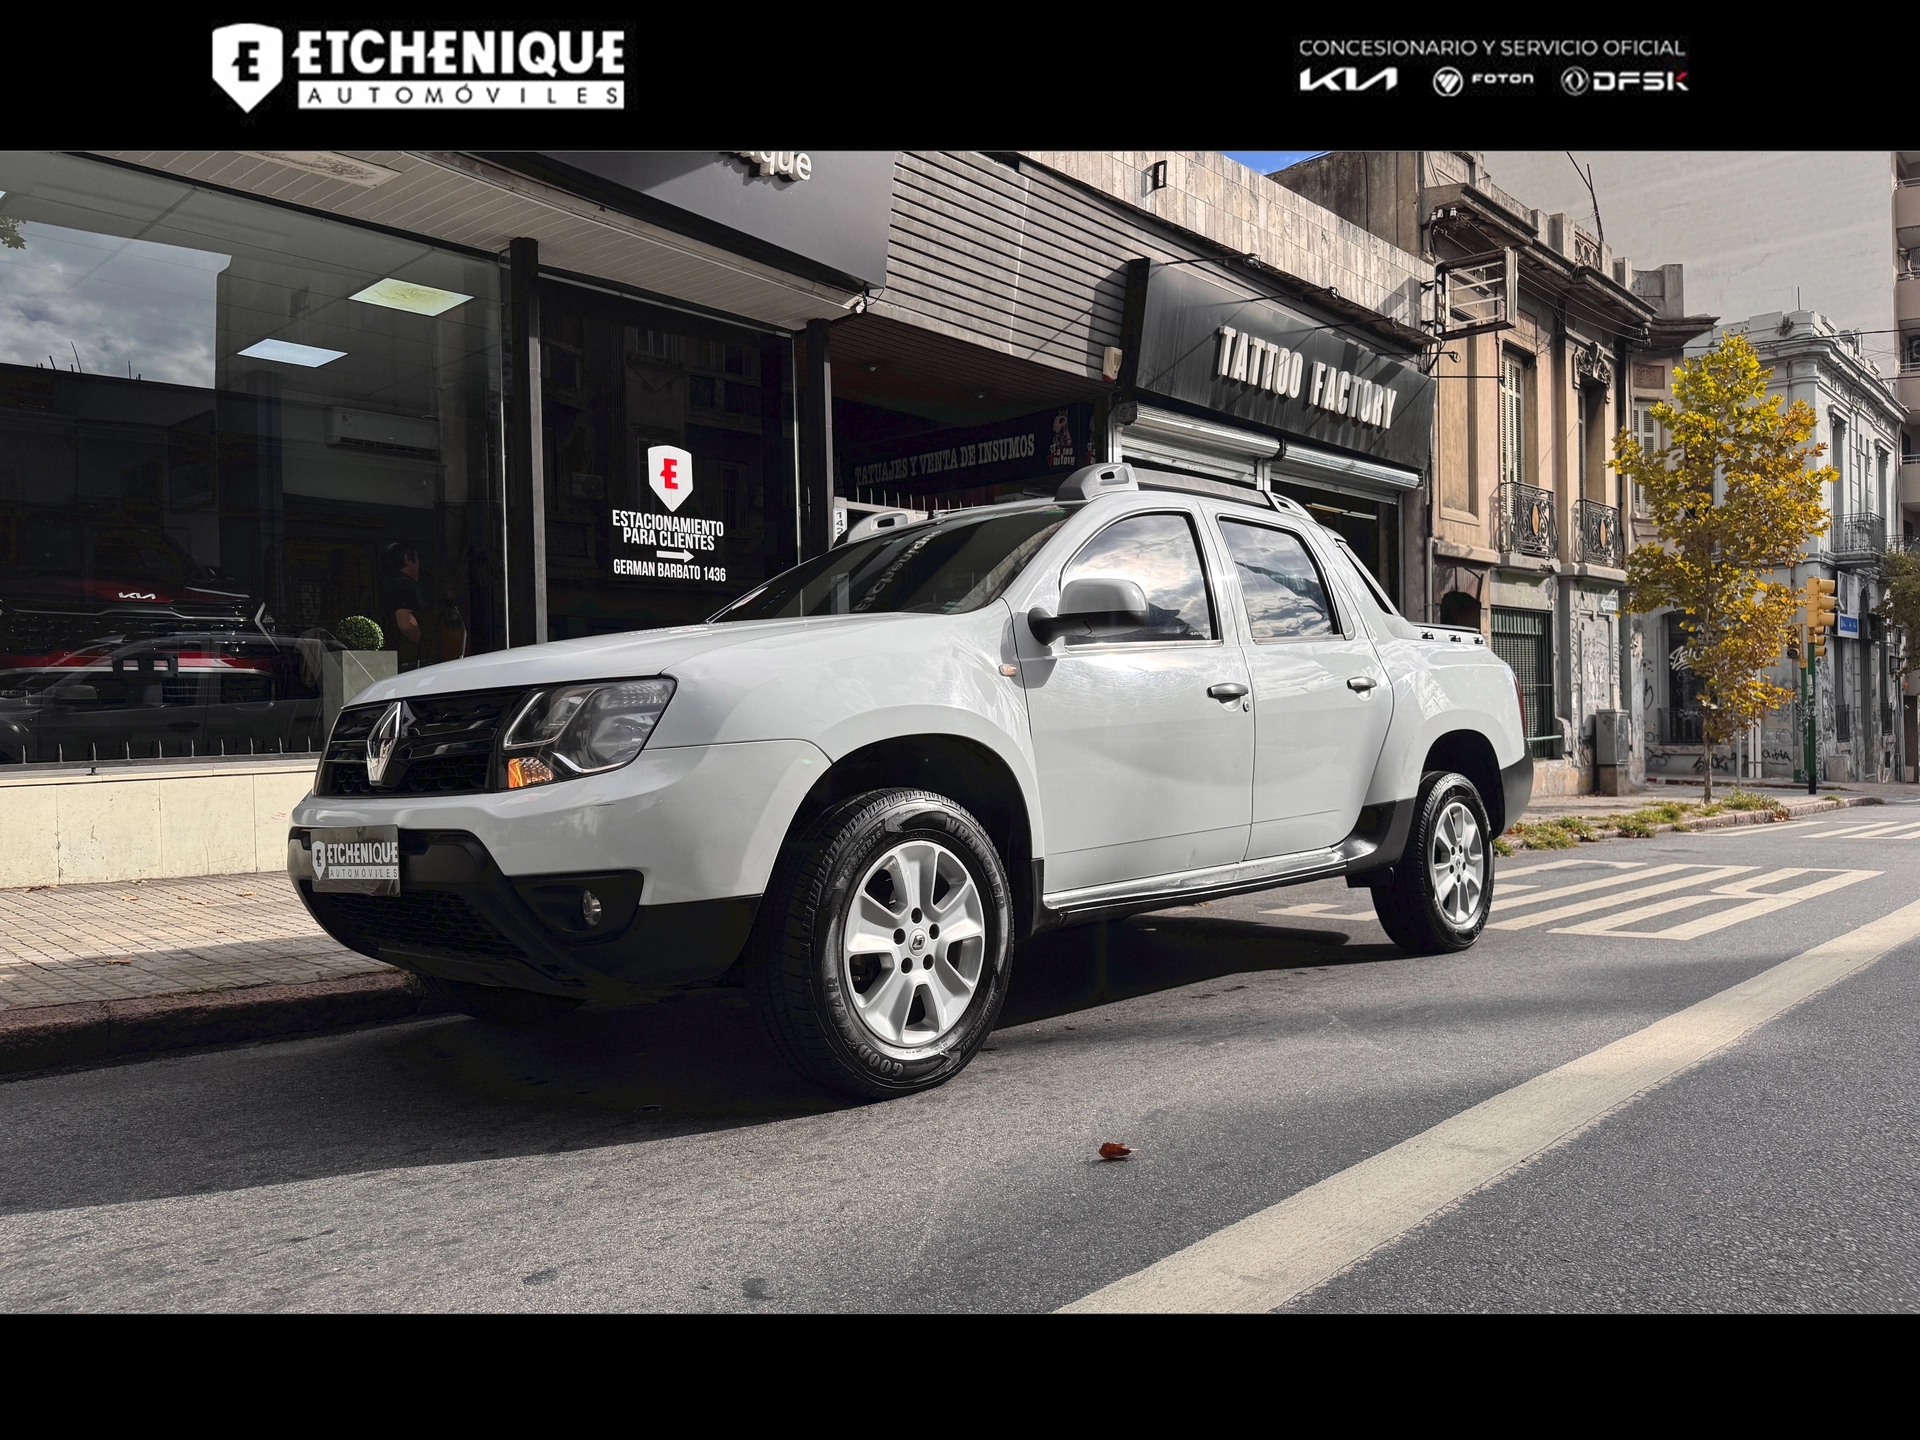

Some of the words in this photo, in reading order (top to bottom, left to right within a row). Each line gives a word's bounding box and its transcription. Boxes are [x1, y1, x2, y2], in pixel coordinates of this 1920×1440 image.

[1217, 325, 1304, 399] TATTOO
[1308, 361, 1397, 429] FACTORY
[854, 457, 908, 486] TATUAJES
[909, 456, 918, 477] Y
[918, 447, 958, 475] VENTA
[960, 443, 977, 469] DE
[978, 433, 1035, 464] INSUMOS
[612, 509, 724, 537] ESTACIONAMIENTO
[623, 526, 657, 546] PARA
[659, 530, 715, 551] CLIENTES
[613, 558, 655, 577] GERMAN
[657, 562, 701, 580] BARBATO
[703, 566, 726, 582] 1436
[327, 842, 399, 865] ETCHENIQUE
[944, 816, 1006, 909] WRANGLER
[330, 868, 398, 878] AUTOMÓVILES
